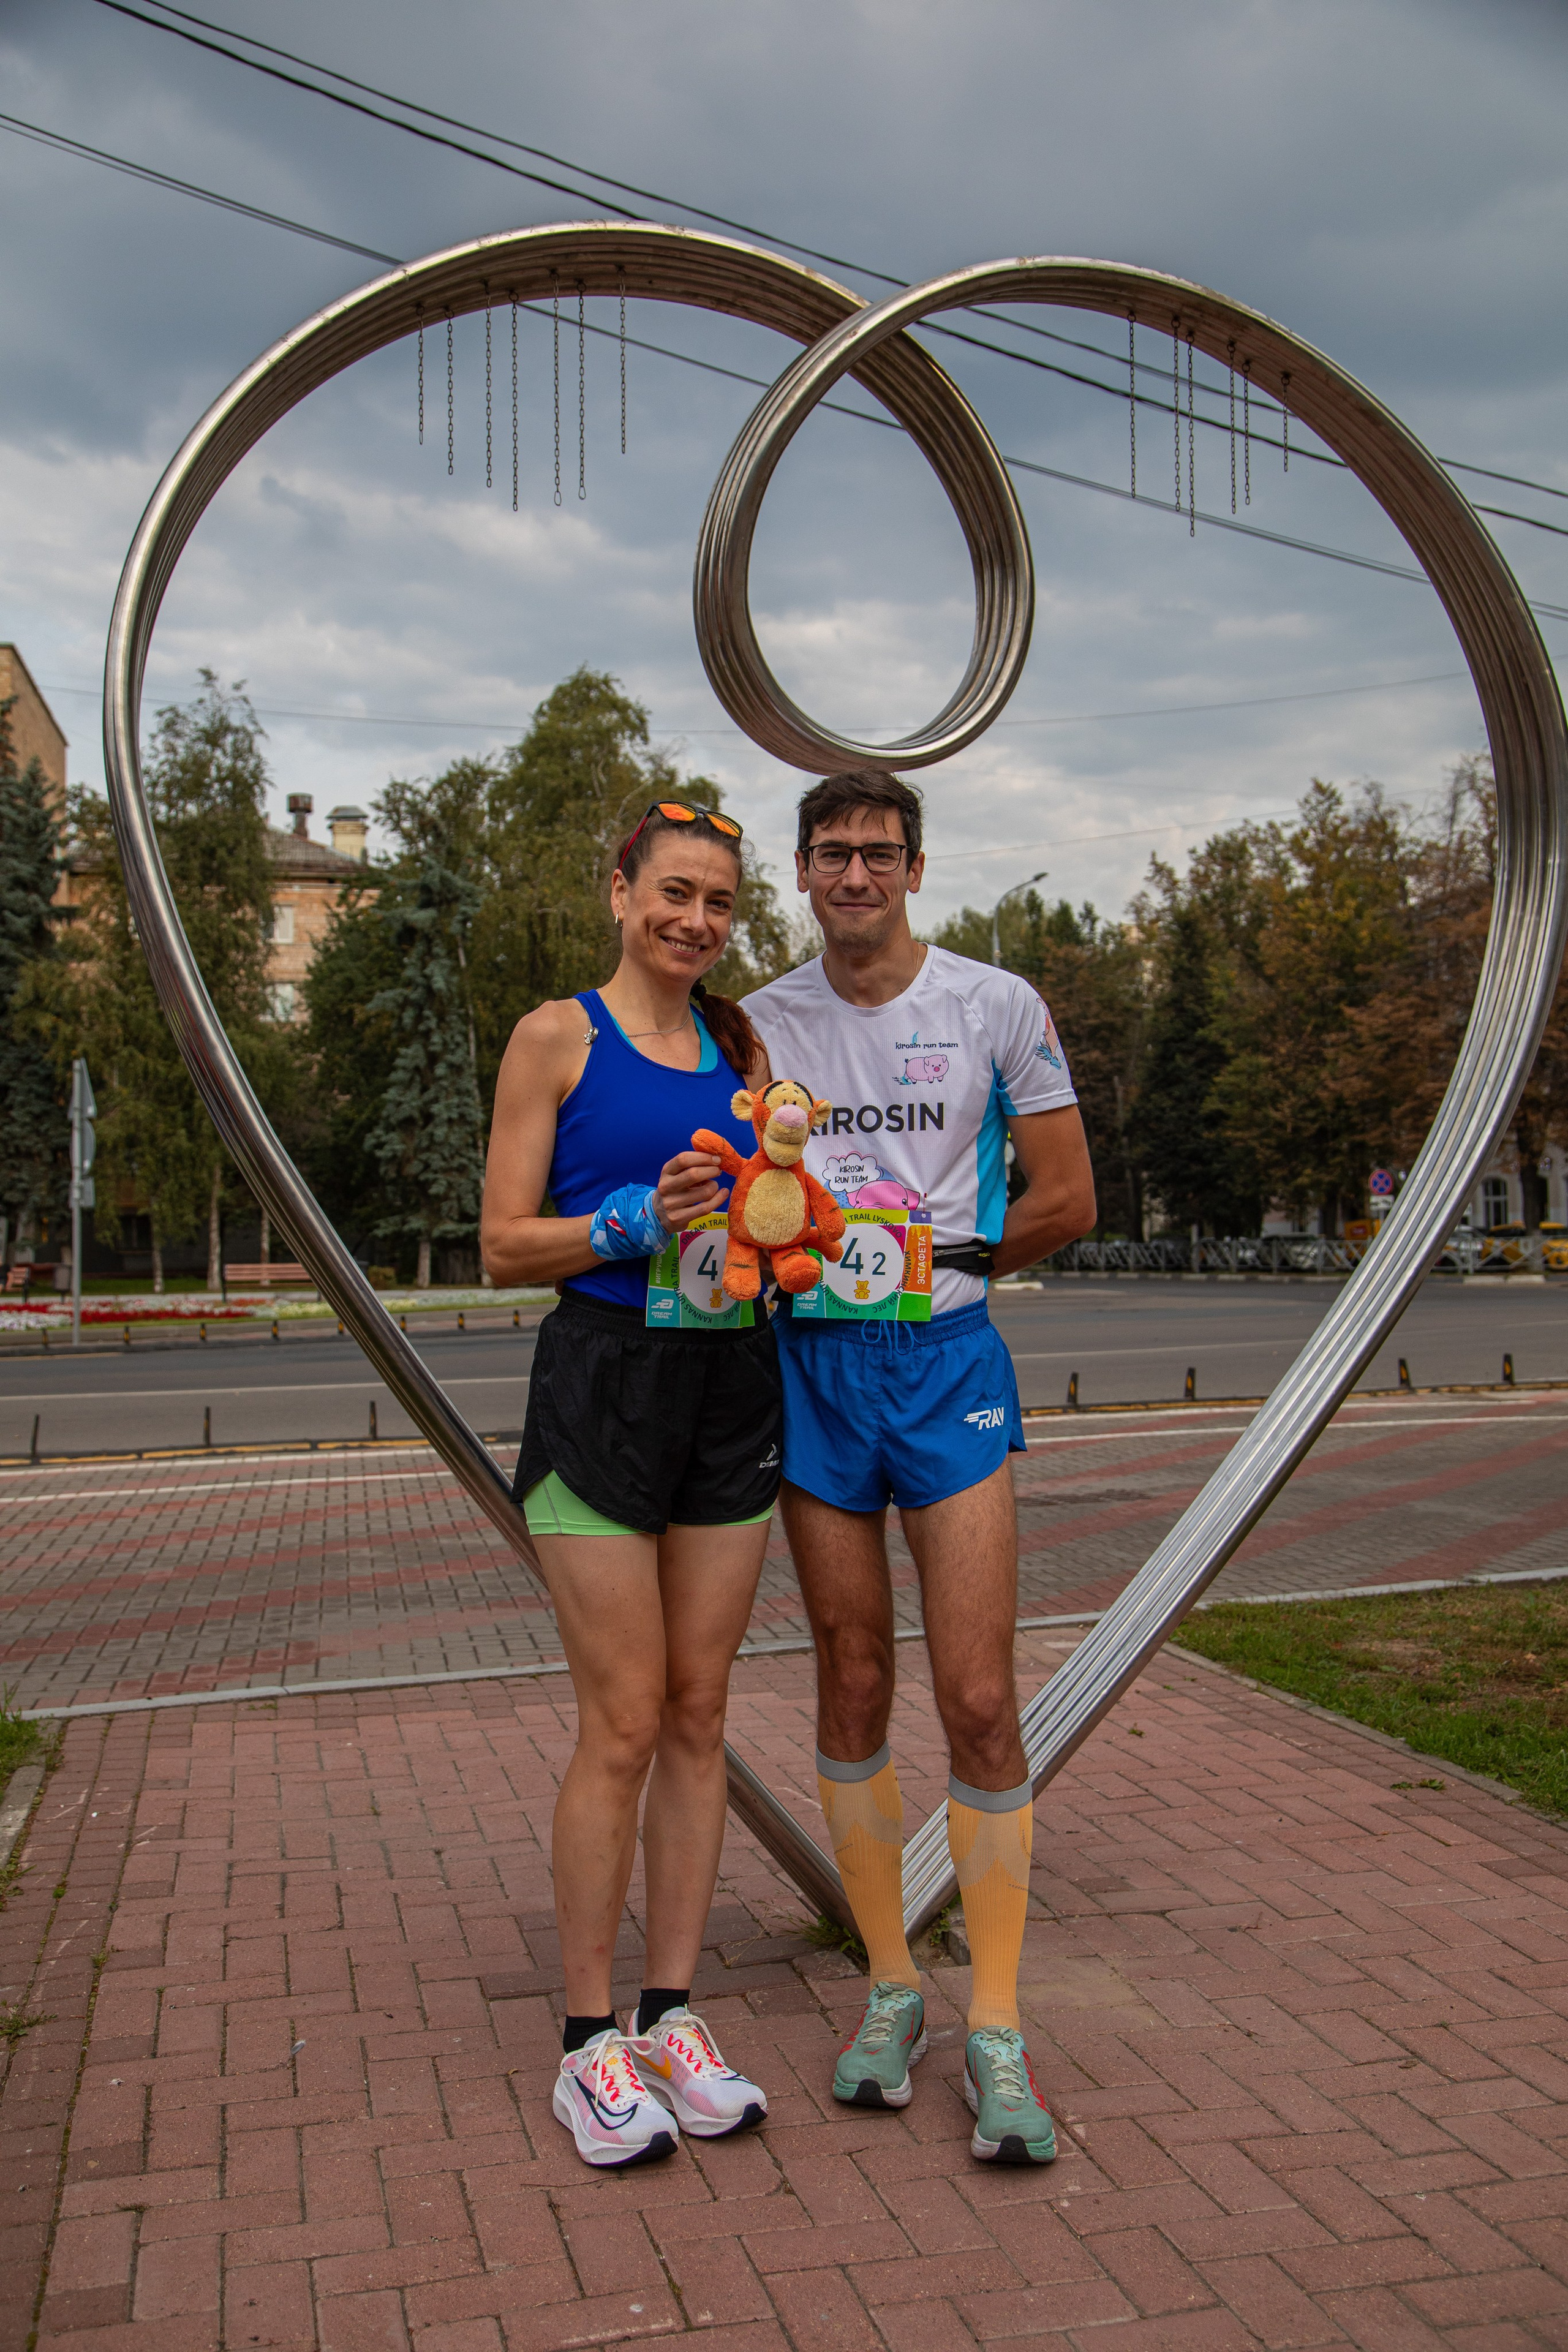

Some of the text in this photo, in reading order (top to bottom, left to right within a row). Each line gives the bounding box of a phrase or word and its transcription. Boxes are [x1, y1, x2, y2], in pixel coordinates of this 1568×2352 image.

[810, 1102, 944, 1136] ROSIN
[681, 1218, 728, 1245] DREAM TRAIL
[849, 1213, 902, 1238] TRAIL LYSKOVO
[671, 1256, 680, 1278] TRAIL
[697, 1245, 718, 1281] 4
[917, 1235, 926, 1285] ЭСТАФЕТА
